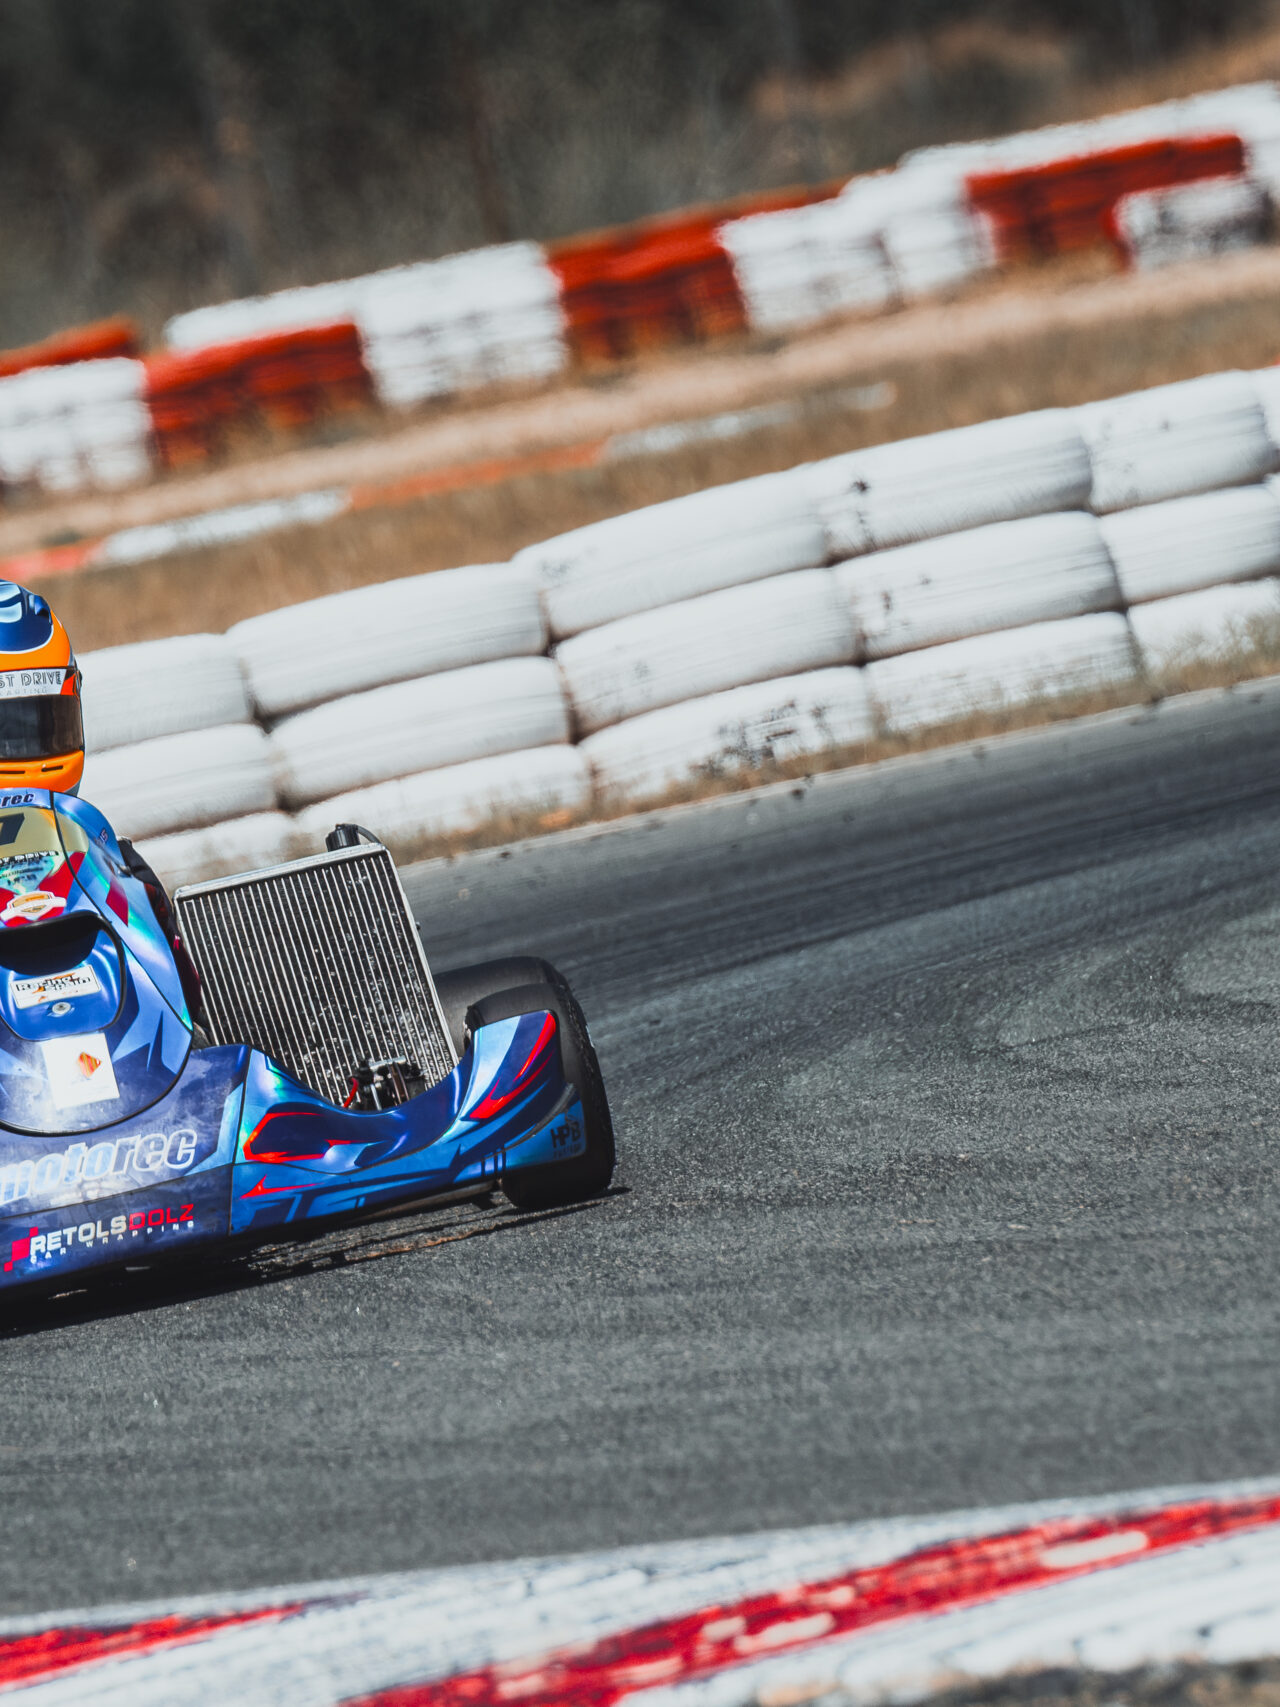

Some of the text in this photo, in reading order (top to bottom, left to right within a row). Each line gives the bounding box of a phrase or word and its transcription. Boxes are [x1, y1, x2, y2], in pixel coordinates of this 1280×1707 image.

[21, 671, 62, 687] DRIVE
[550, 1121, 581, 1149] HPB
[30, 1203, 194, 1255] RETOLSDOLZ
[30, 1220, 194, 1264] CAR WRAPPING
